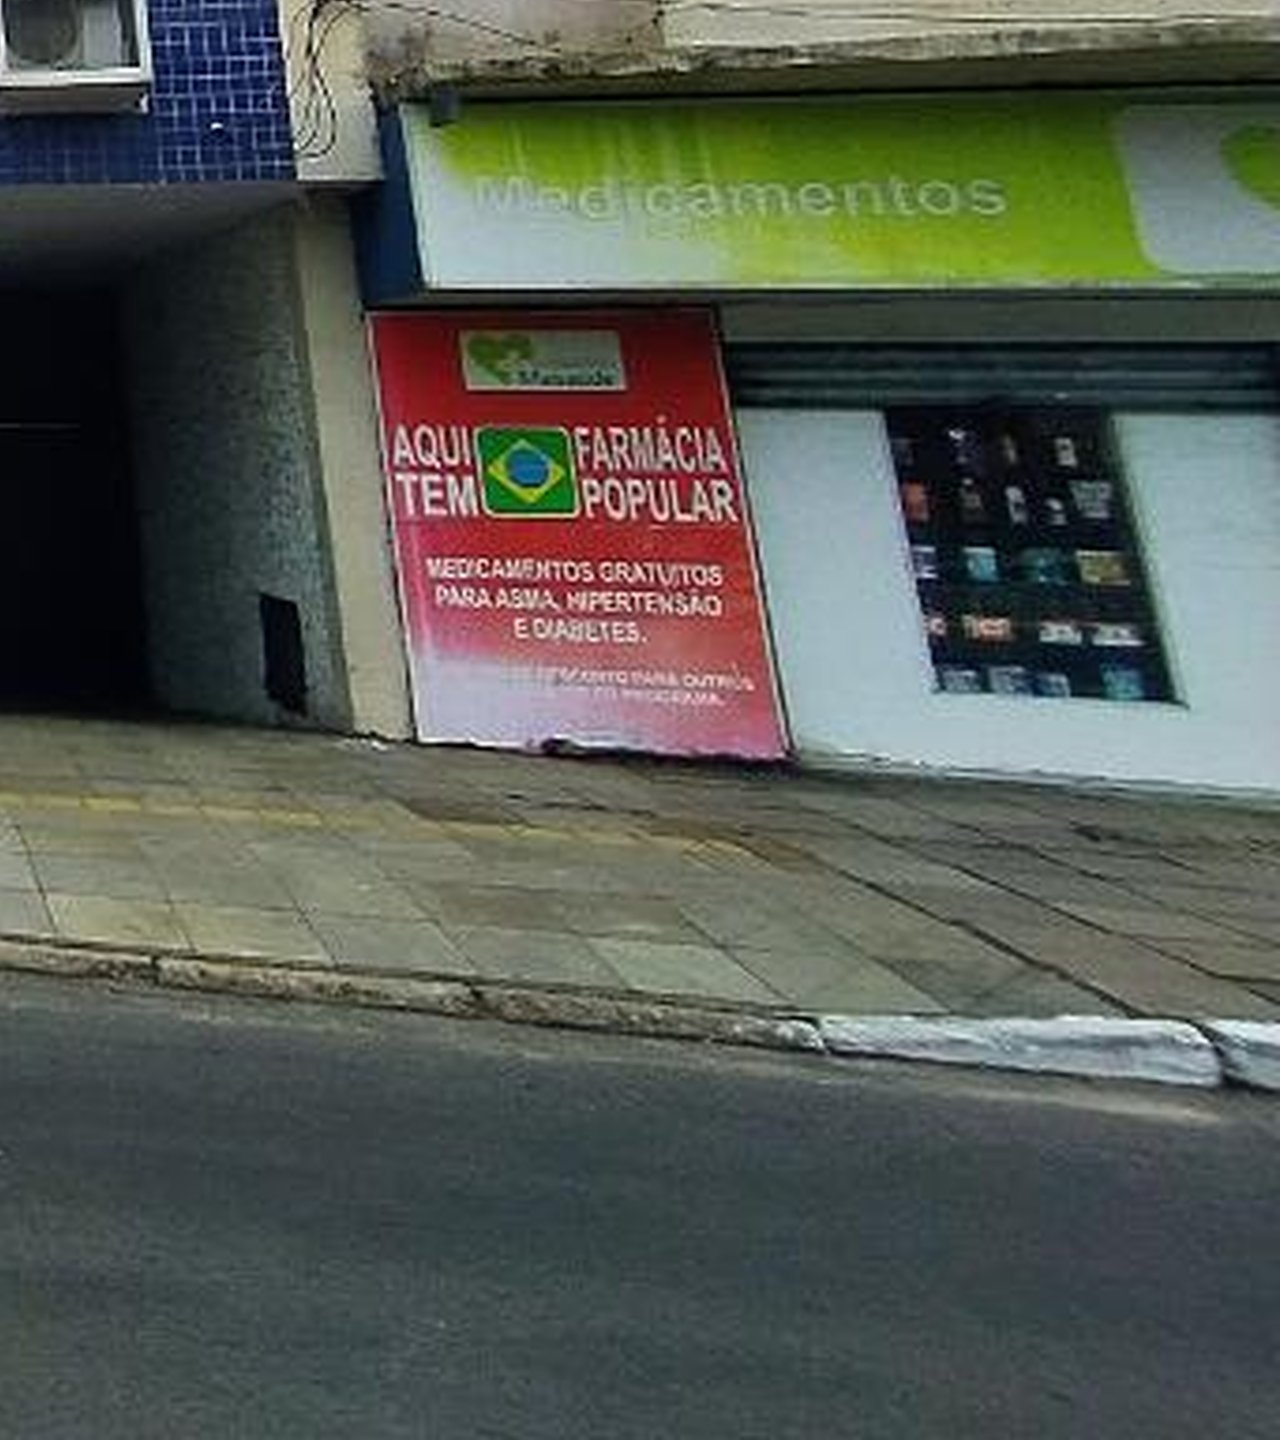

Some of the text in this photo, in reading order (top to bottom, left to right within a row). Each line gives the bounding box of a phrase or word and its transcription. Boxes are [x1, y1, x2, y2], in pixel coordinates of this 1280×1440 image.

[473, 174, 1007, 219] Medicamentos
[393, 425, 472, 469] AQUI
[573, 415, 729, 474] FARMÁCIA
[394, 472, 480, 517] TEM
[582, 479, 740, 523] POPULAR
[426, 556, 724, 588] MEDICAMENTOS GRATUITOS
[434, 586, 493, 609] PARA
[566, 589, 723, 617] HIPERTENSÃO
[513, 618, 529, 639] E
